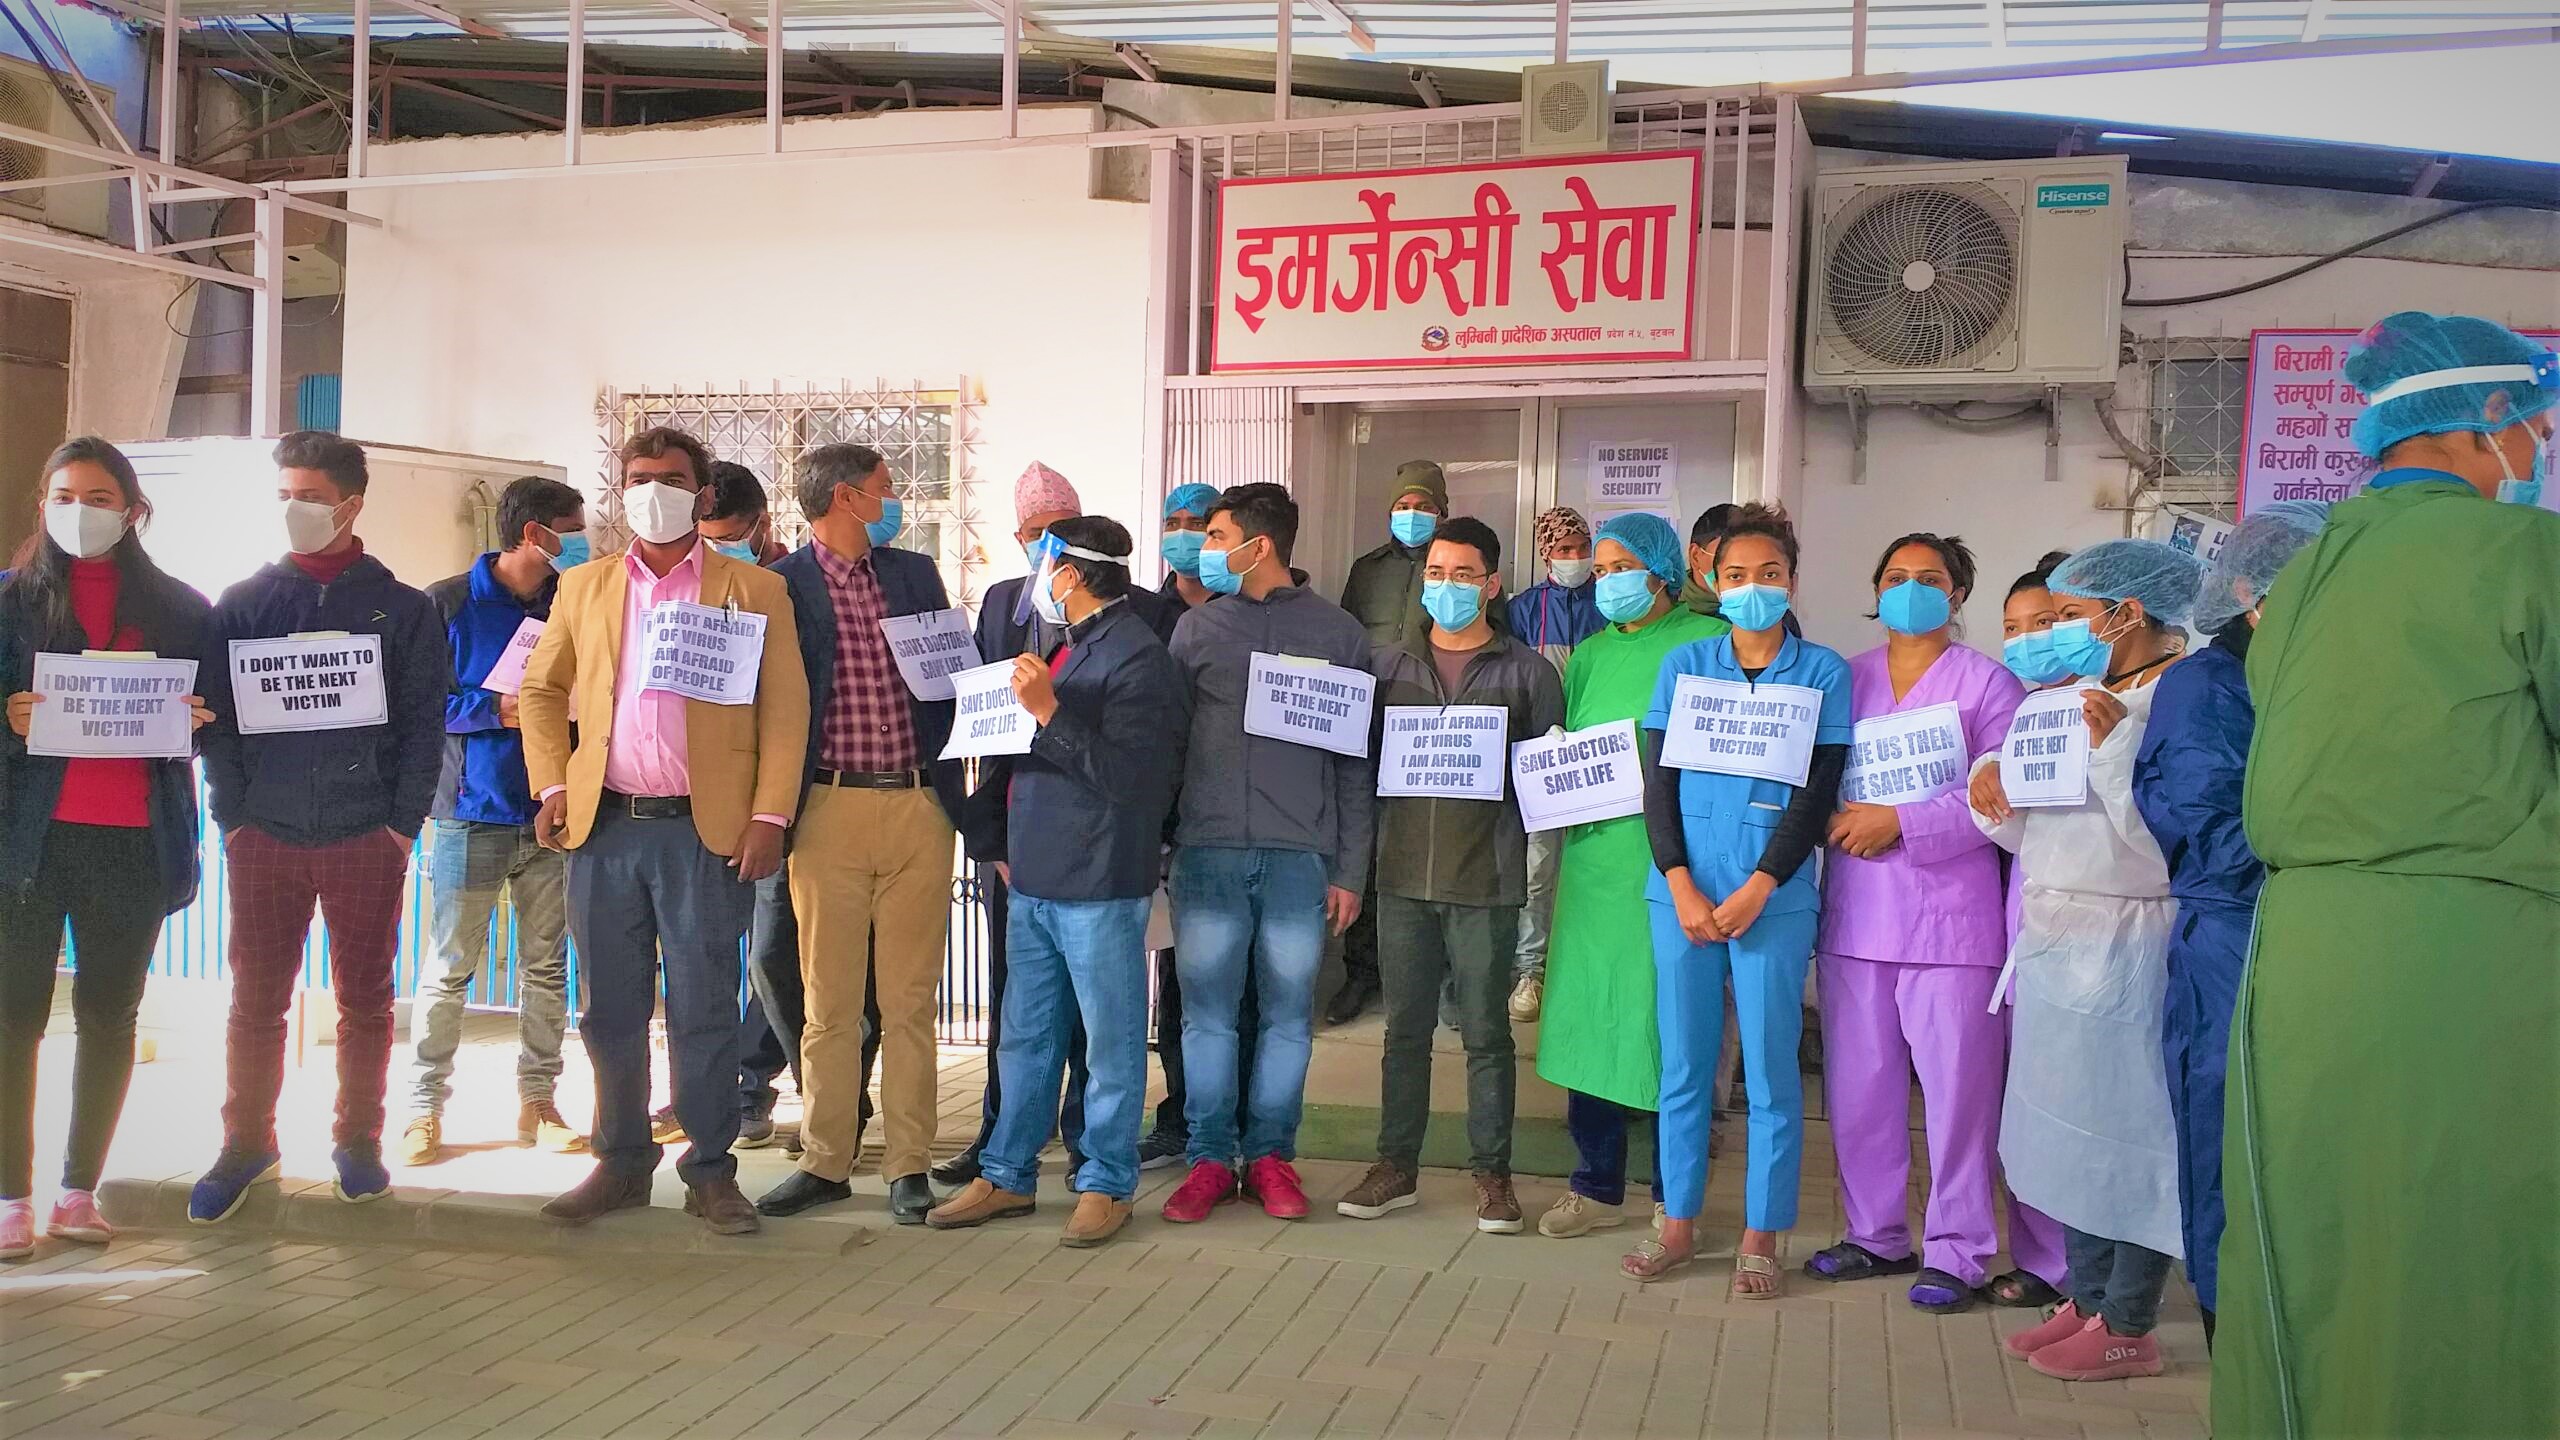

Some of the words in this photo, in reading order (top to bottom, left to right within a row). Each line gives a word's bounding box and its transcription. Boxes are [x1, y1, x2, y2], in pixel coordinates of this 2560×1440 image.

[2040, 191, 2106, 202] Hisense
[1235, 182, 1520, 334] इमर्जेन्सी
[1541, 176, 1676, 313] सेवा
[1455, 327, 1498, 348] लुम्बिनी
[1501, 324, 1548, 345] प्रादेशिक
[1551, 327, 1602, 343] अस्पताल
[2274, 344, 2335, 372] बिरामी
[2273, 379, 2335, 410] सम्पूर्ण
[1598, 449, 1615, 461] NO
[1618, 448, 1668, 461] SERVICE
[2258, 443, 2319, 470] बिरामी
[1604, 465, 1661, 478] WITHOUT
[1602, 482, 1661, 495] SECURITY
[670, 611, 700, 626] NOT
[702, 616, 757, 637] AFRAID
[659, 629, 679, 641] OF
[681, 629, 727, 652] VIRUS
[894, 636, 924, 658] SAVE
[924, 630, 970, 653] DOCTORS
[240, 659, 245, 673] I
[250, 655, 297, 673] DON'T
[302, 652, 349, 668] WANT
[353, 649, 373, 664] TO
[654, 647, 679, 662] AM
[681, 650, 735, 674] AFRAID
[919, 658, 946, 680] SAVE
[945, 655, 964, 675] LIFE
[44, 674, 50, 689] I
[54, 674, 107, 693] DON'T
[111, 677, 162, 693] WANT
[165, 677, 185, 693] TO
[260, 678, 281, 692] BE
[284, 675, 315, 691] THE
[319, 671, 357, 688] NEXT
[652, 665, 672, 679] OF
[674, 667, 725, 692] PEOPLE
[1257, 669, 1262, 682] I
[1265, 671, 1305, 689] DON'T
[1308, 678, 1348, 698] WANT
[1350, 686, 1367, 702] TO
[63, 697, 85, 713] BE
[89, 698, 120, 715] THE
[124, 699, 165, 715] NEXT
[282, 693, 341, 711] VICTIM
[961, 692, 984, 715] SAVE
[986, 685, 1020, 710] DOCTO
[1270, 689, 1288, 704] BE
[1290, 692, 1316, 710] THE
[1318, 698, 1351, 718] NEXT
[1682, 694, 1688, 708] I
[1690, 695, 1738, 715] DON'T
[1740, 700, 1788, 718] WANT
[1791, 704, 1811, 723] TO
[81, 720, 144, 736] VICTIM
[970, 716, 994, 738] SAVE
[997, 713, 1017, 734] LIFE
[1284, 710, 1333, 733] VICTIM
[1391, 718, 1396, 731] I
[1398, 718, 1419, 731] AM
[1421, 717, 1447, 731] NOT
[1448, 716, 1499, 730] AFRAID
[1694, 716, 1715, 732] BE
[1718, 718, 1747, 735] THE
[1749, 721, 1790, 739] NEXT
[2014, 713, 2037, 734] DON'T
[2038, 709, 2066, 730] WANT
[2067, 707, 2082, 727] TO
[1413, 735, 1429, 749] OF
[1431, 734, 1472, 748] VIRUS
[1520, 749, 1556, 774] SAVE
[1557, 732, 1631, 765] DOCTORS
[1709, 737, 1767, 757] VICTIM
[1846, 741, 1874, 769] AVE
[1875, 735, 1902, 762] US
[1904, 725, 1955, 756] THEN
[2014, 739, 2025, 758] BE
[2026, 737, 2044, 756] THE
[2046, 734, 2068, 755] NEXT
[1401, 755, 1406, 768] I
[1408, 755, 1429, 768] AM
[1431, 754, 1482, 768] AFRAID
[1406, 772, 1422, 786] OF
[1424, 772, 1474, 787] PEOPLE
[1543, 769, 1583, 795] SAVE
[1583, 762, 1615, 787] LIFE
[1868, 766, 1916, 798] SAVE
[1916, 758, 1957, 788] YOU
